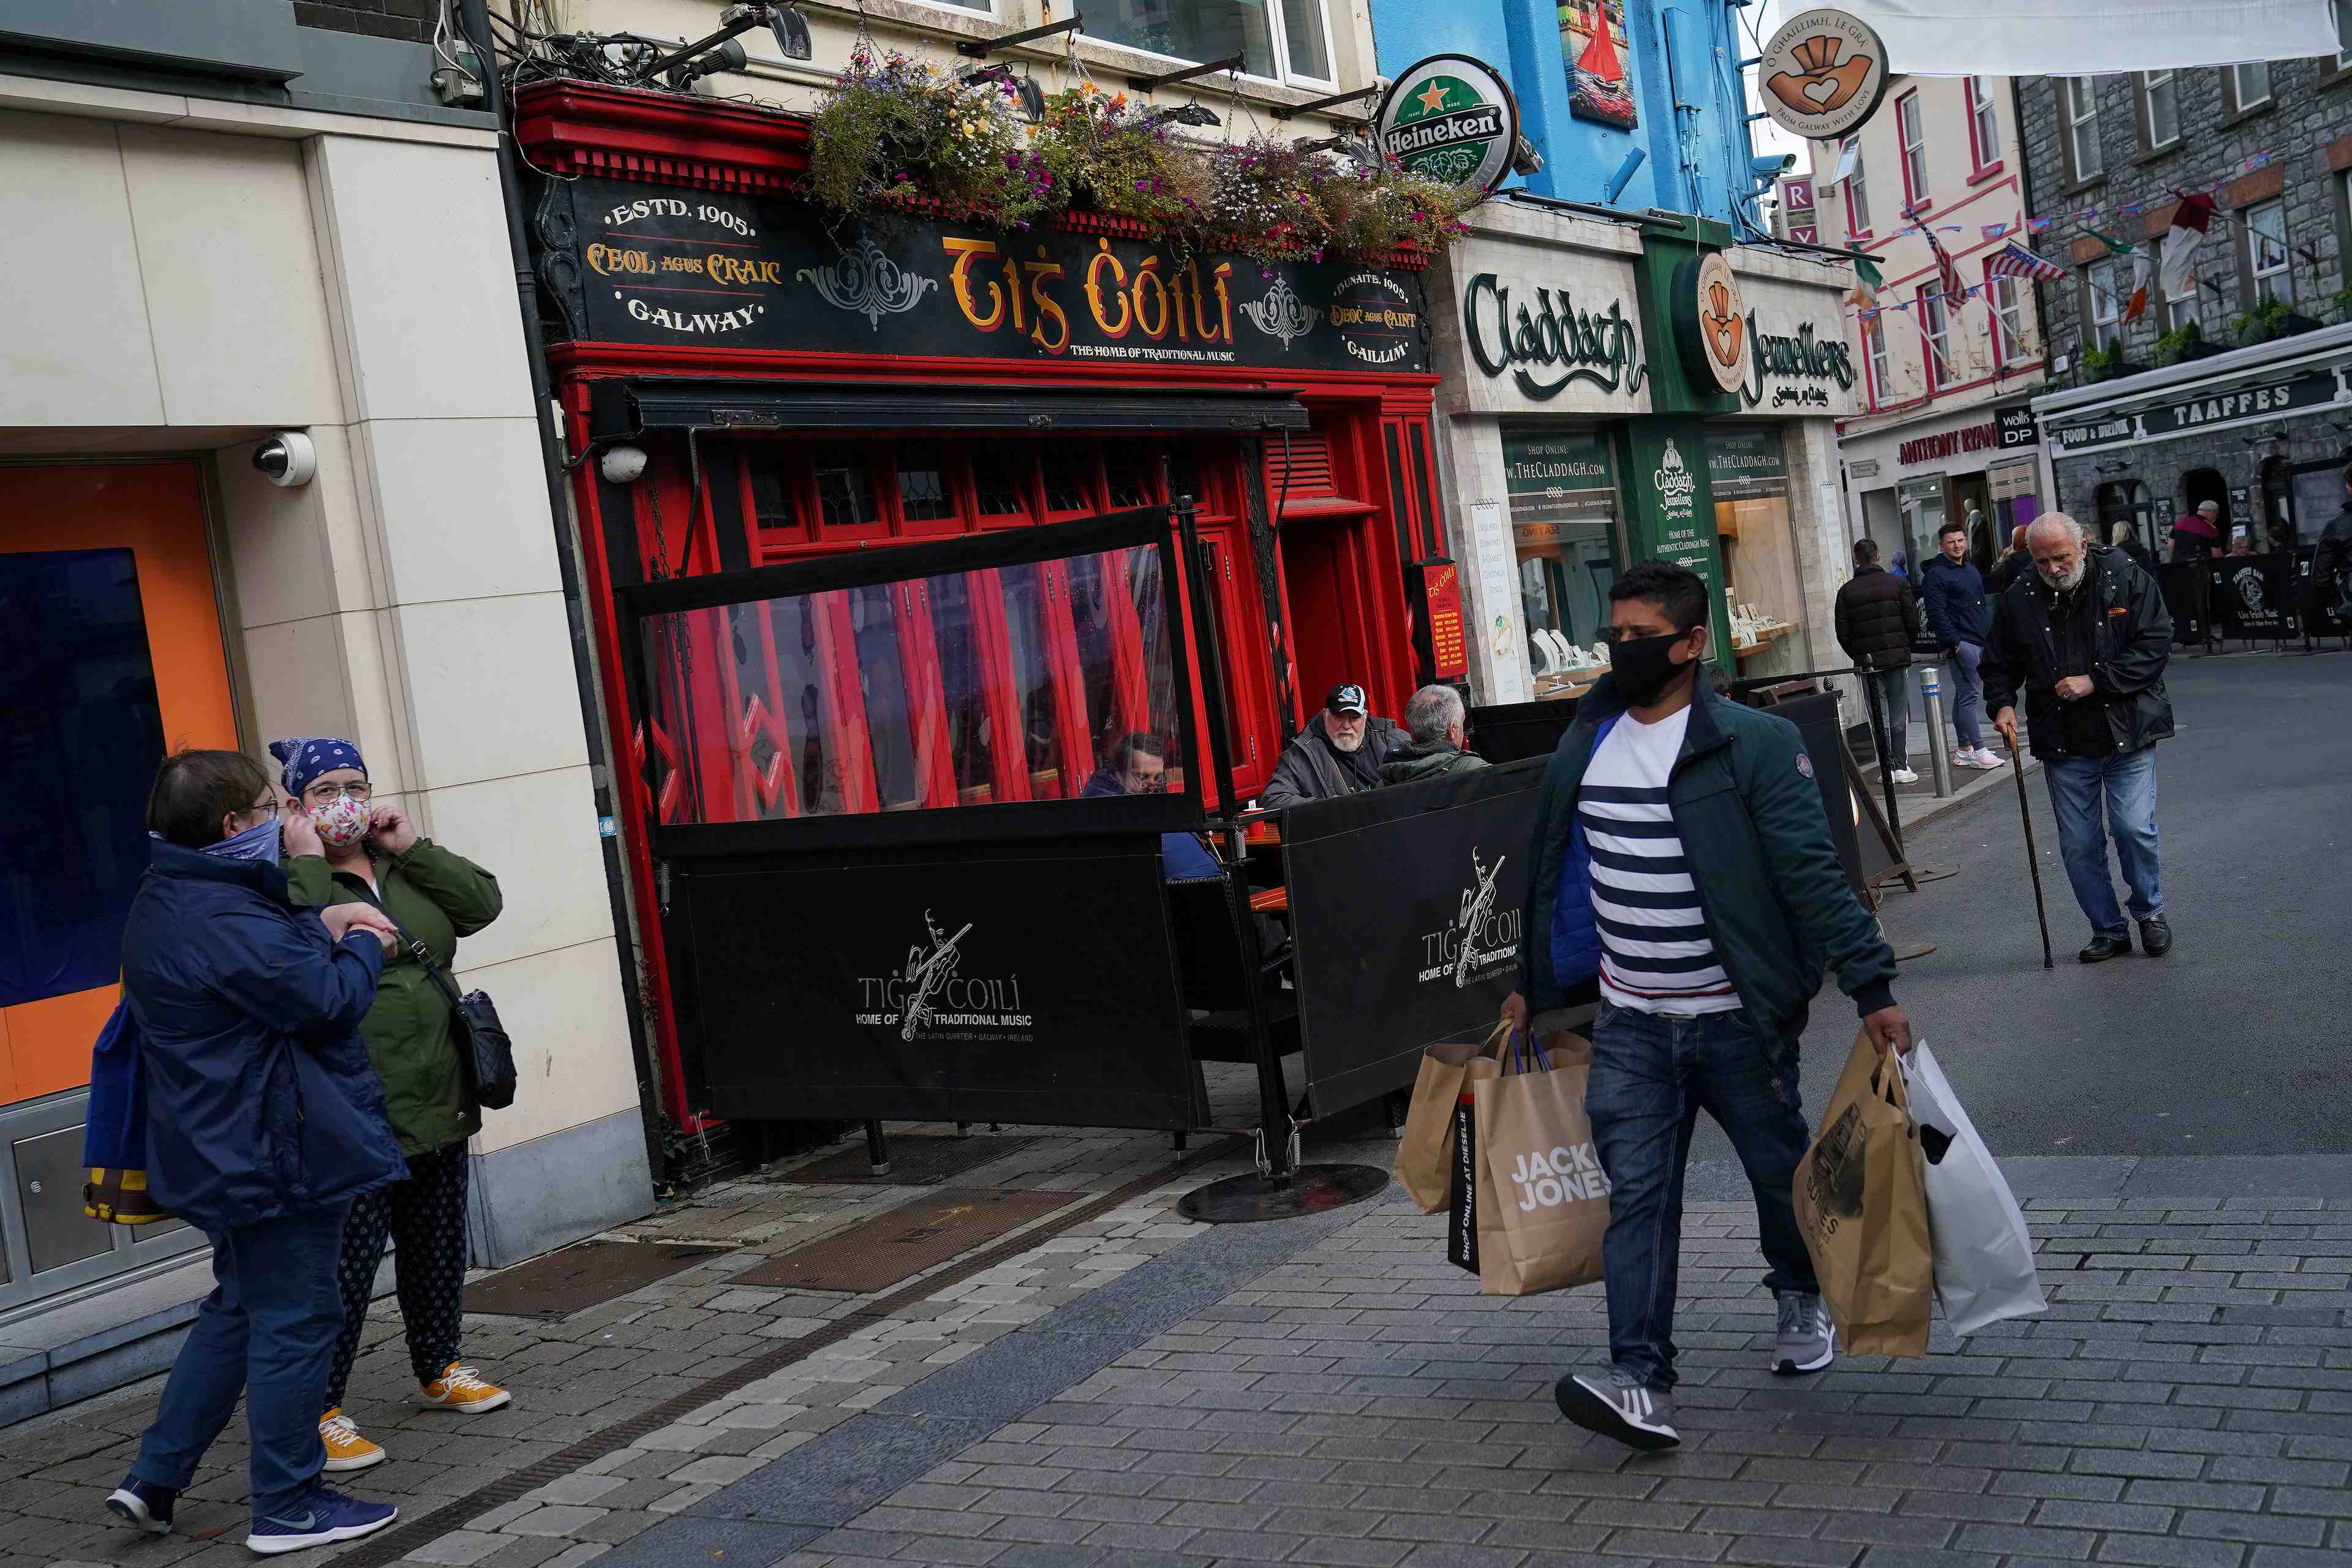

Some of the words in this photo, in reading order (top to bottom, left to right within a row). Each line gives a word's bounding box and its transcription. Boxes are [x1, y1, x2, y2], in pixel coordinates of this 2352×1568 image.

[1834, 17, 1847, 30] LE
[1776, 107, 1796, 126] FROM
[1798, 121, 1830, 131] GALWAY
[1833, 110, 1854, 127] WITH
[1853, 88, 1870, 110] LOVE
[1387, 114, 1497, 154] Heineken
[611, 198, 692, 227] ESTD.
[586, 242, 657, 277] CEOL
[661, 255, 704, 274] AGUS
[706, 253, 785, 286] CRAIC
[627, 298, 757, 334] GALWAY
[1464, 273, 1650, 401] Claddagh
[1070, 344, 1095, 356] THE
[1095, 347, 1127, 358] HOME
[1128, 347, 1142, 359] OF
[1142, 348, 1205, 361] TRADITIONAL
[1205, 350, 1235, 363] MUSIC
[1740, 307, 1853, 407] Jewellers
[2173, 386, 2291, 425] TAAFFES
[1725, 440, 1736, 450] SHOP
[2004, 429, 2032, 444] DP
[2062, 428, 2087, 445] FOOD
[2090, 428, 2096, 439] &
[2098, 419, 2130, 438] DRINK
[1528, 445, 1543, 455] SHOP
[1900, 431, 1959, 466] ANTHONY
[1506, 461, 1605, 480] W.THECLADDAGH.COM
[1654, 469, 1695, 496] Claddagh
[1660, 493, 1692, 510] Jewellers
[1656, 543, 1679, 554] AUTHENTIC
[1679, 540, 1700, 551] CLADDAGH
[1668, 530, 1681, 540] HOME
[1686, 529, 1695, 537] THE
[1419, 966, 1441, 982] HOME
[1442, 963, 1453, 976] OF
[856, 1014, 882, 1025] HOME
[884, 1014, 899, 1025] OF
[933, 1014, 999, 1026] TRADITIONAL
[1000, 1014, 1033, 1027] MUSIC
[1007, 1034, 1034, 1042] IRELAND
[1460, 1110, 1470, 1164] DIESEL.IE
[1464, 1166, 1471, 1182] AT
[1510, 1142, 1597, 1183] JACK
[1462, 1183, 1472, 1228] ONLINE
